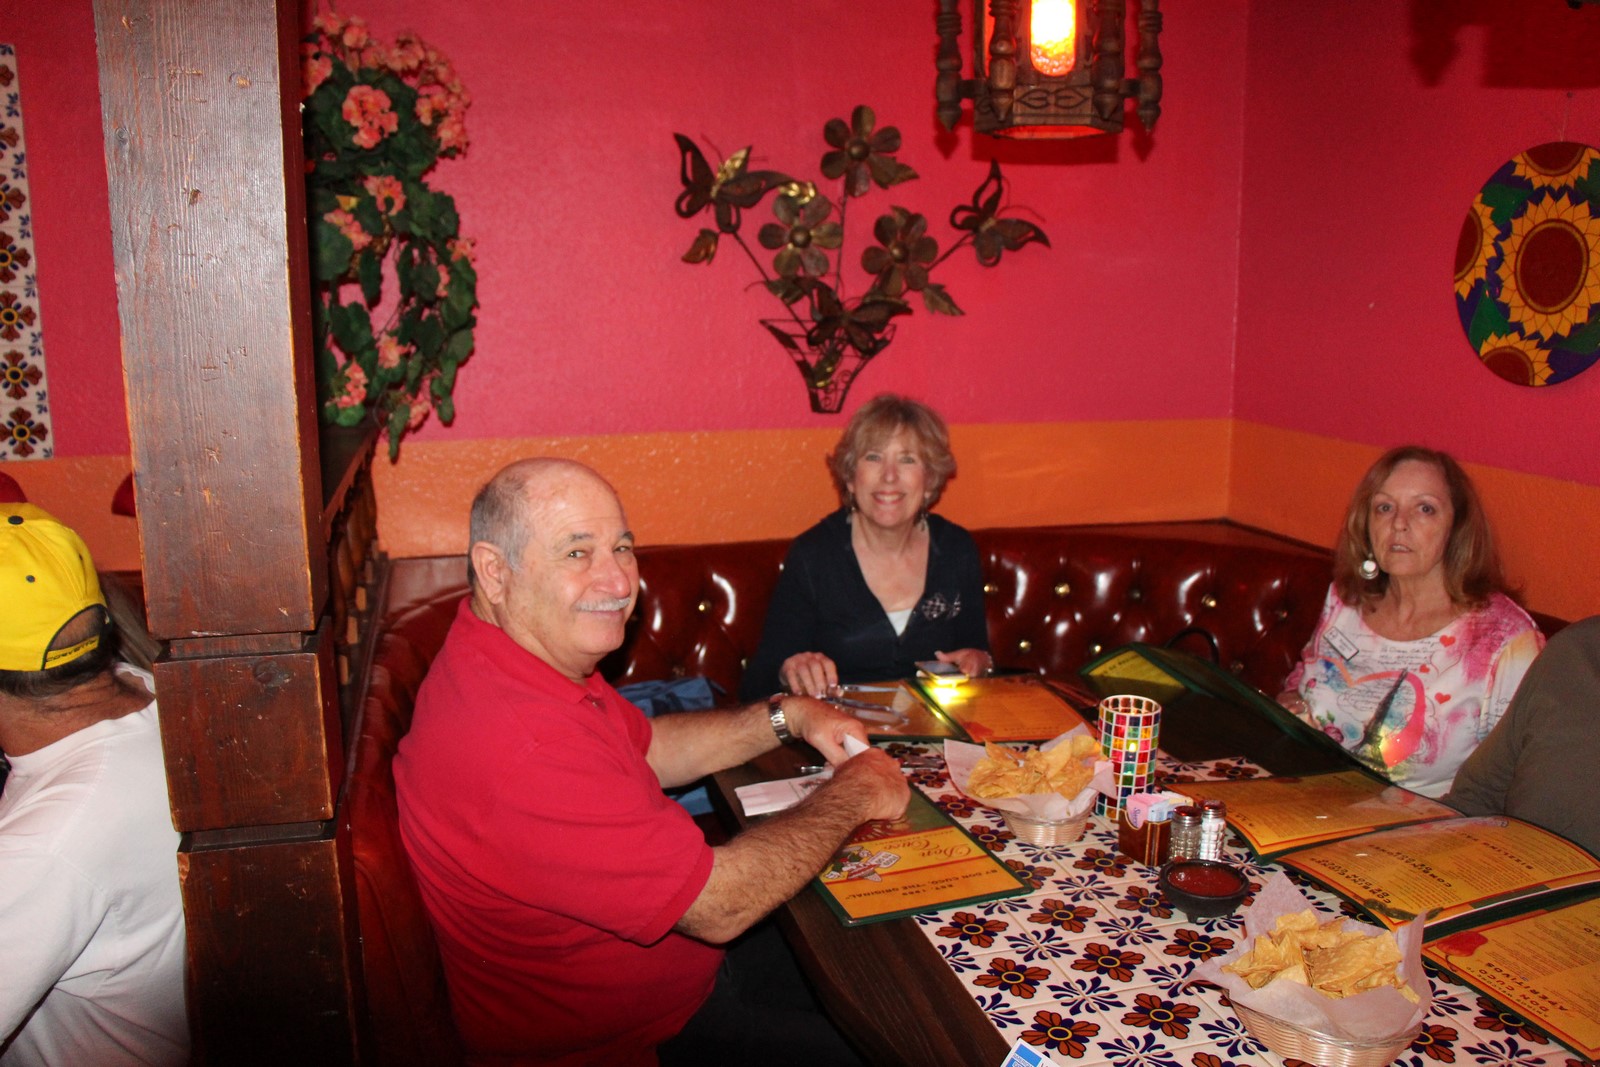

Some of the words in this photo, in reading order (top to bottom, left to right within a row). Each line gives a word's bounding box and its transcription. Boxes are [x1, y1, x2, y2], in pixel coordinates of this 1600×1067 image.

[884, 839, 940, 851] Cuco
[920, 844, 971, 860] Don
[1310, 857, 1392, 904] COMBINACIONES
[1351, 873, 1373, 887] DON
[1375, 887, 1390, 898] DE
[1477, 974, 1513, 997] WELCOME
[1479, 969, 1515, 991] CUCO
[1486, 962, 1568, 1011] APERITIVOS
[1520, 994, 1549, 1011] DON
